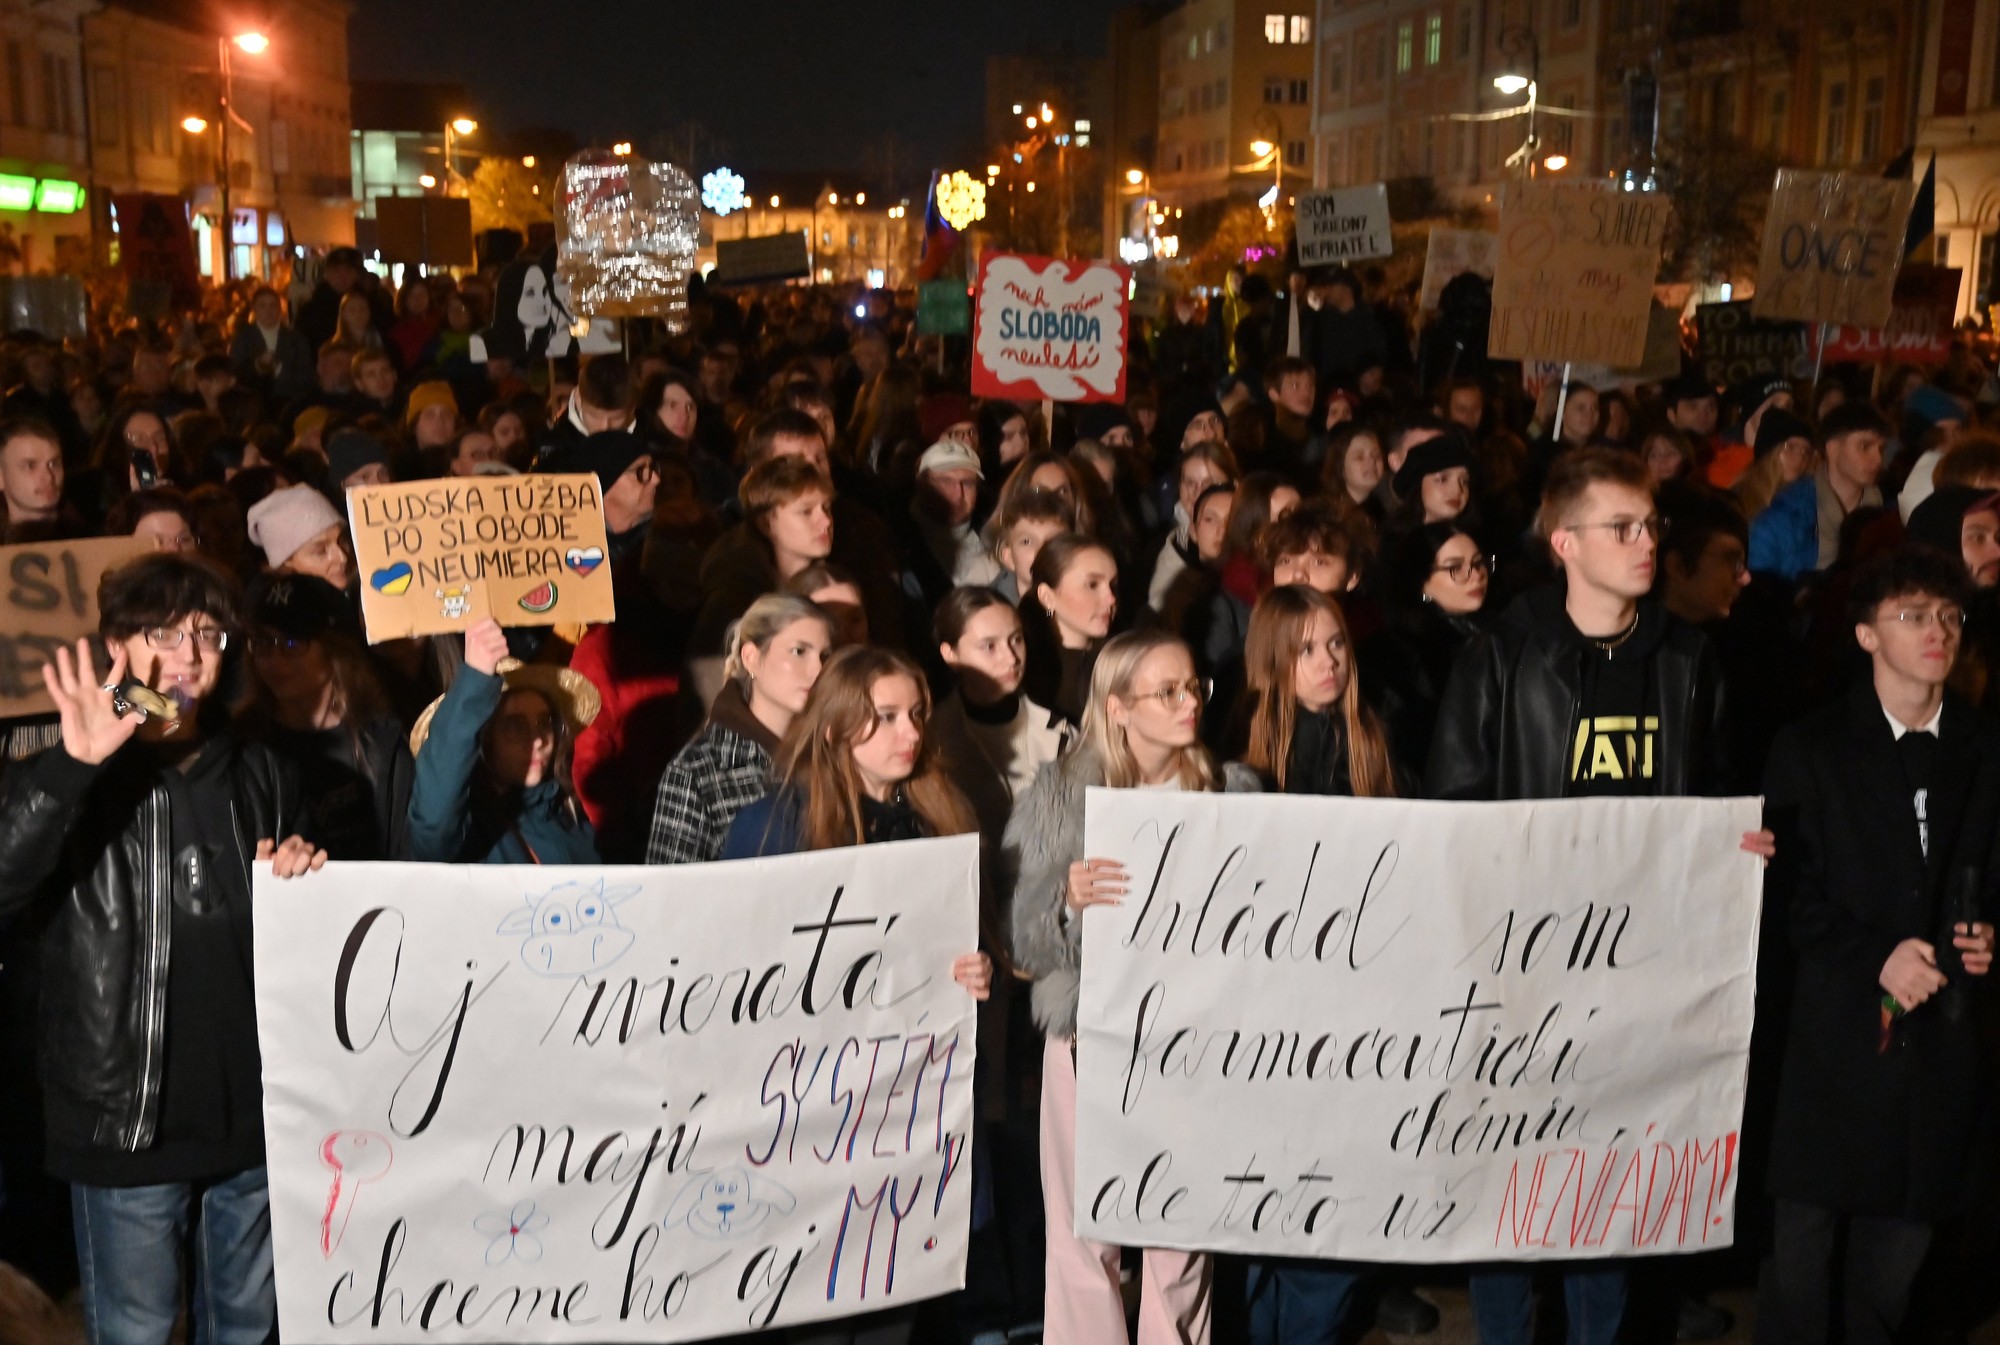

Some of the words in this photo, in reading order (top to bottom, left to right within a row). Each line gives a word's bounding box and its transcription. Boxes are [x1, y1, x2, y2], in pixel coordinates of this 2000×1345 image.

[1301, 195, 1335, 219] SOM
[1781, 223, 1888, 279] ONCE
[1000, 307, 1101, 343] SLOBODA
[362, 485, 485, 528] ĽUDSKA
[494, 477, 597, 511] TÚŽBA
[384, 524, 423, 557] PO
[440, 511, 579, 550] SLOBODE
[418, 546, 563, 587] NEUMIERA
[540, 884, 932, 1047] zvieratá
[1454, 901, 1662, 975] som
[483, 1092, 713, 1250] majú
[1091, 1149, 1194, 1225] ale
[1209, 1152, 1366, 1235] toto
[1367, 1164, 1485, 1241] už
[1494, 1121, 1738, 1249] NEZVLÁDAM!
[328, 1217, 602, 1331] chceme
[619, 1222, 733, 1323] ho
[738, 1224, 821, 1329] aj
[827, 1131, 966, 1301] MY!
